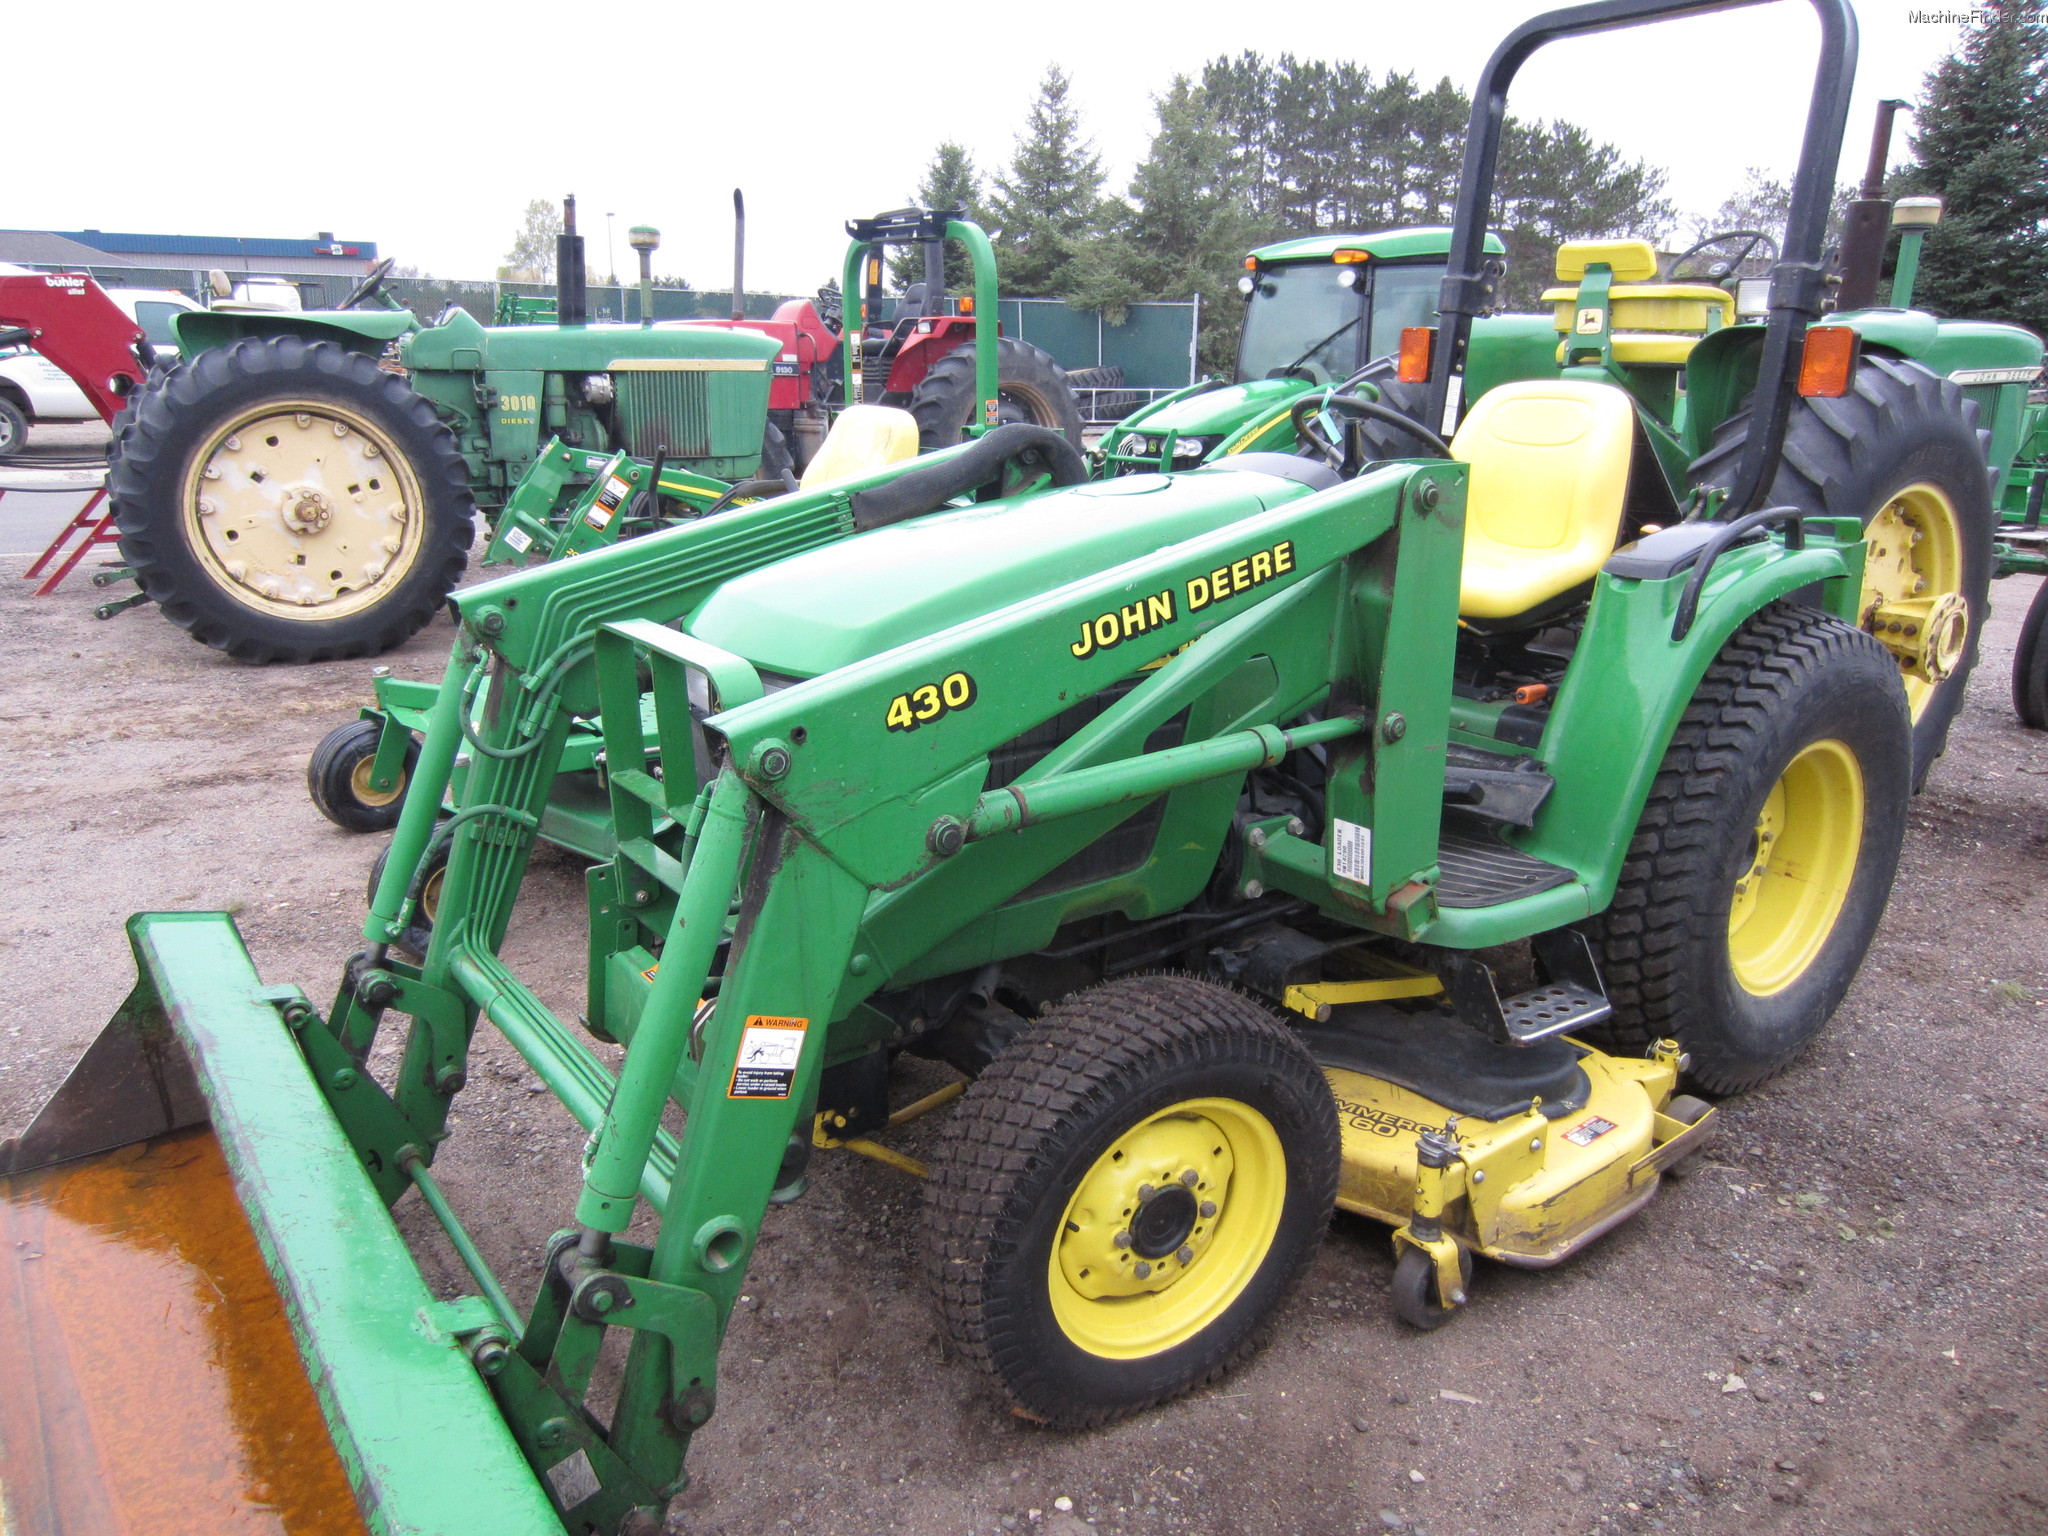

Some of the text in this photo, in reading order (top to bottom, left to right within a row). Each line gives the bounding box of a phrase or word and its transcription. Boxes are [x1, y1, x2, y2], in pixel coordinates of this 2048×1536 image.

[45, 276, 86, 287] bühler
[500, 395, 536, 412] 3010
[1070, 539, 1296, 660] JOHN DEERE
[885, 670, 978, 733] 430
[765, 1018, 803, 1028] WARNING
[1349, 1116, 1400, 1137] 60
